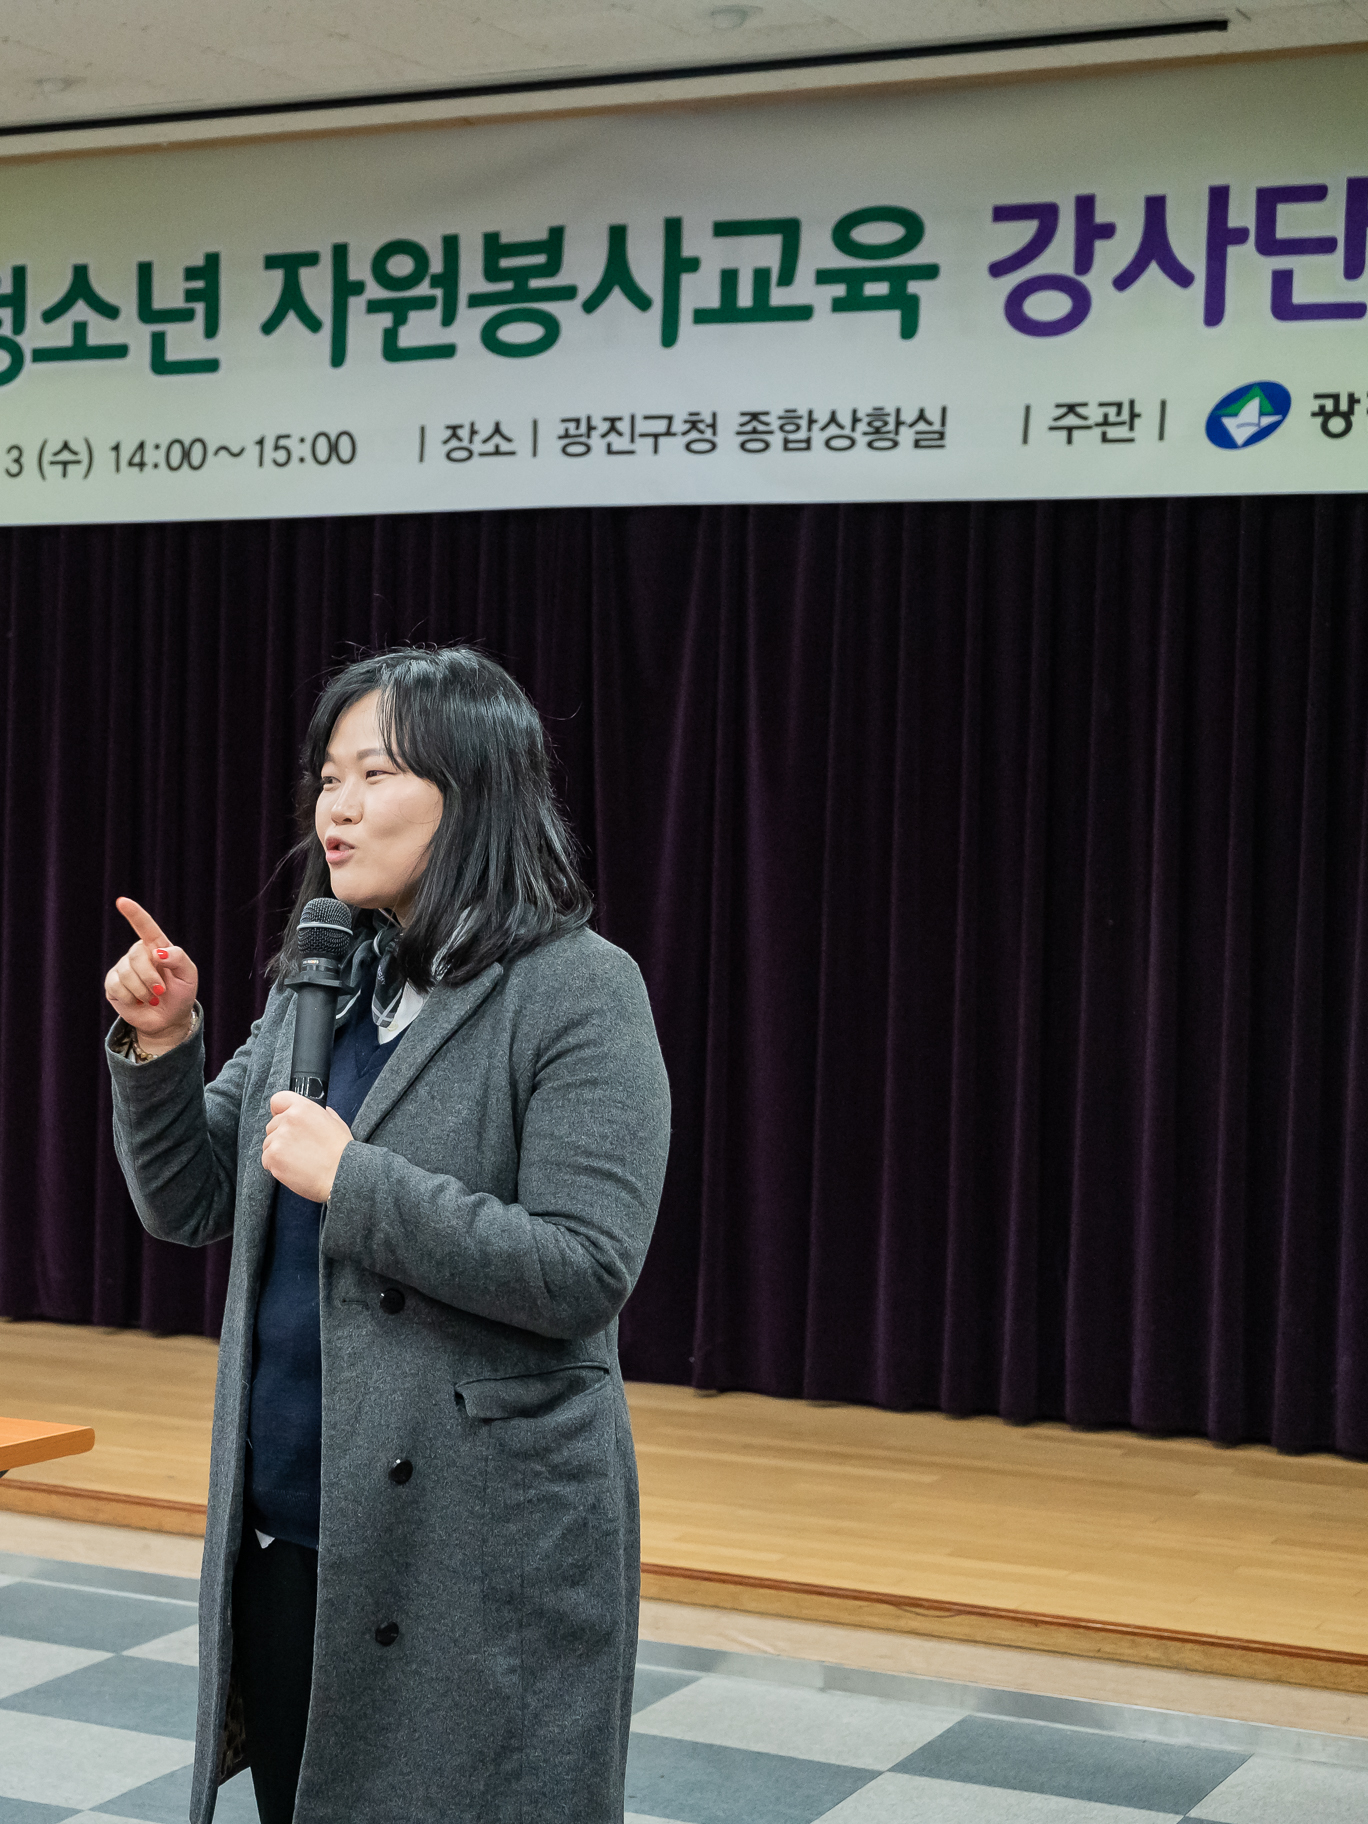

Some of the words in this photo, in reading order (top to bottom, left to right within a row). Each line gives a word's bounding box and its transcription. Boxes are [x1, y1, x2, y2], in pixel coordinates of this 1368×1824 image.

[260, 204, 941, 370] 자원봉사교육
[987, 175, 1368, 339] 강사단
[37, 437, 94, 480] (수)
[109, 430, 357, 474] 14:00~15:00
[557, 412, 718, 458] 광진구청
[734, 405, 949, 454] 종합상황실
